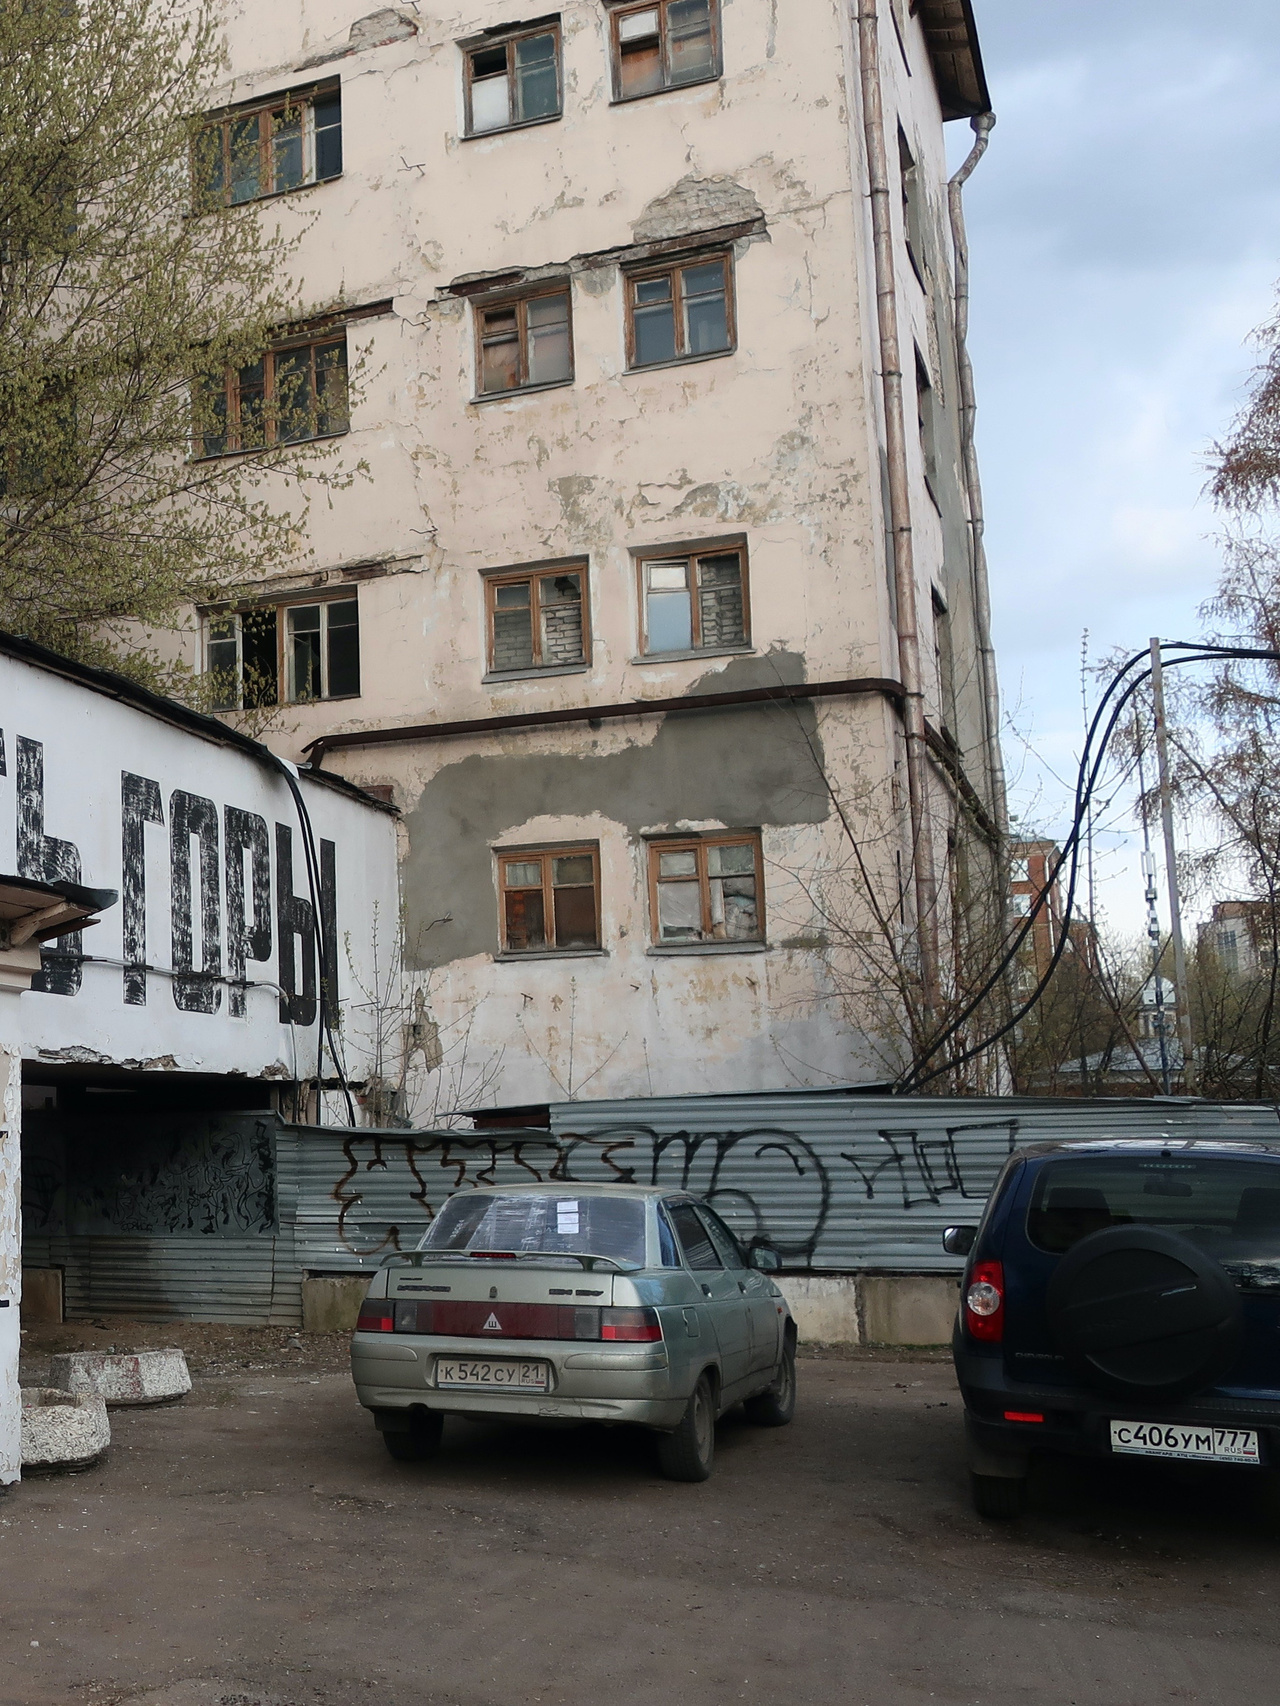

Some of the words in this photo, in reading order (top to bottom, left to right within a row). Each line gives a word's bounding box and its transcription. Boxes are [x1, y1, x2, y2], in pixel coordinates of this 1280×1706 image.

[120, 769, 340, 1029] ГОРЫ
[521, 1364, 540, 1379] 21
[1214, 1429, 1251, 1448] 777
[1224, 1446, 1242, 1455] RUS
